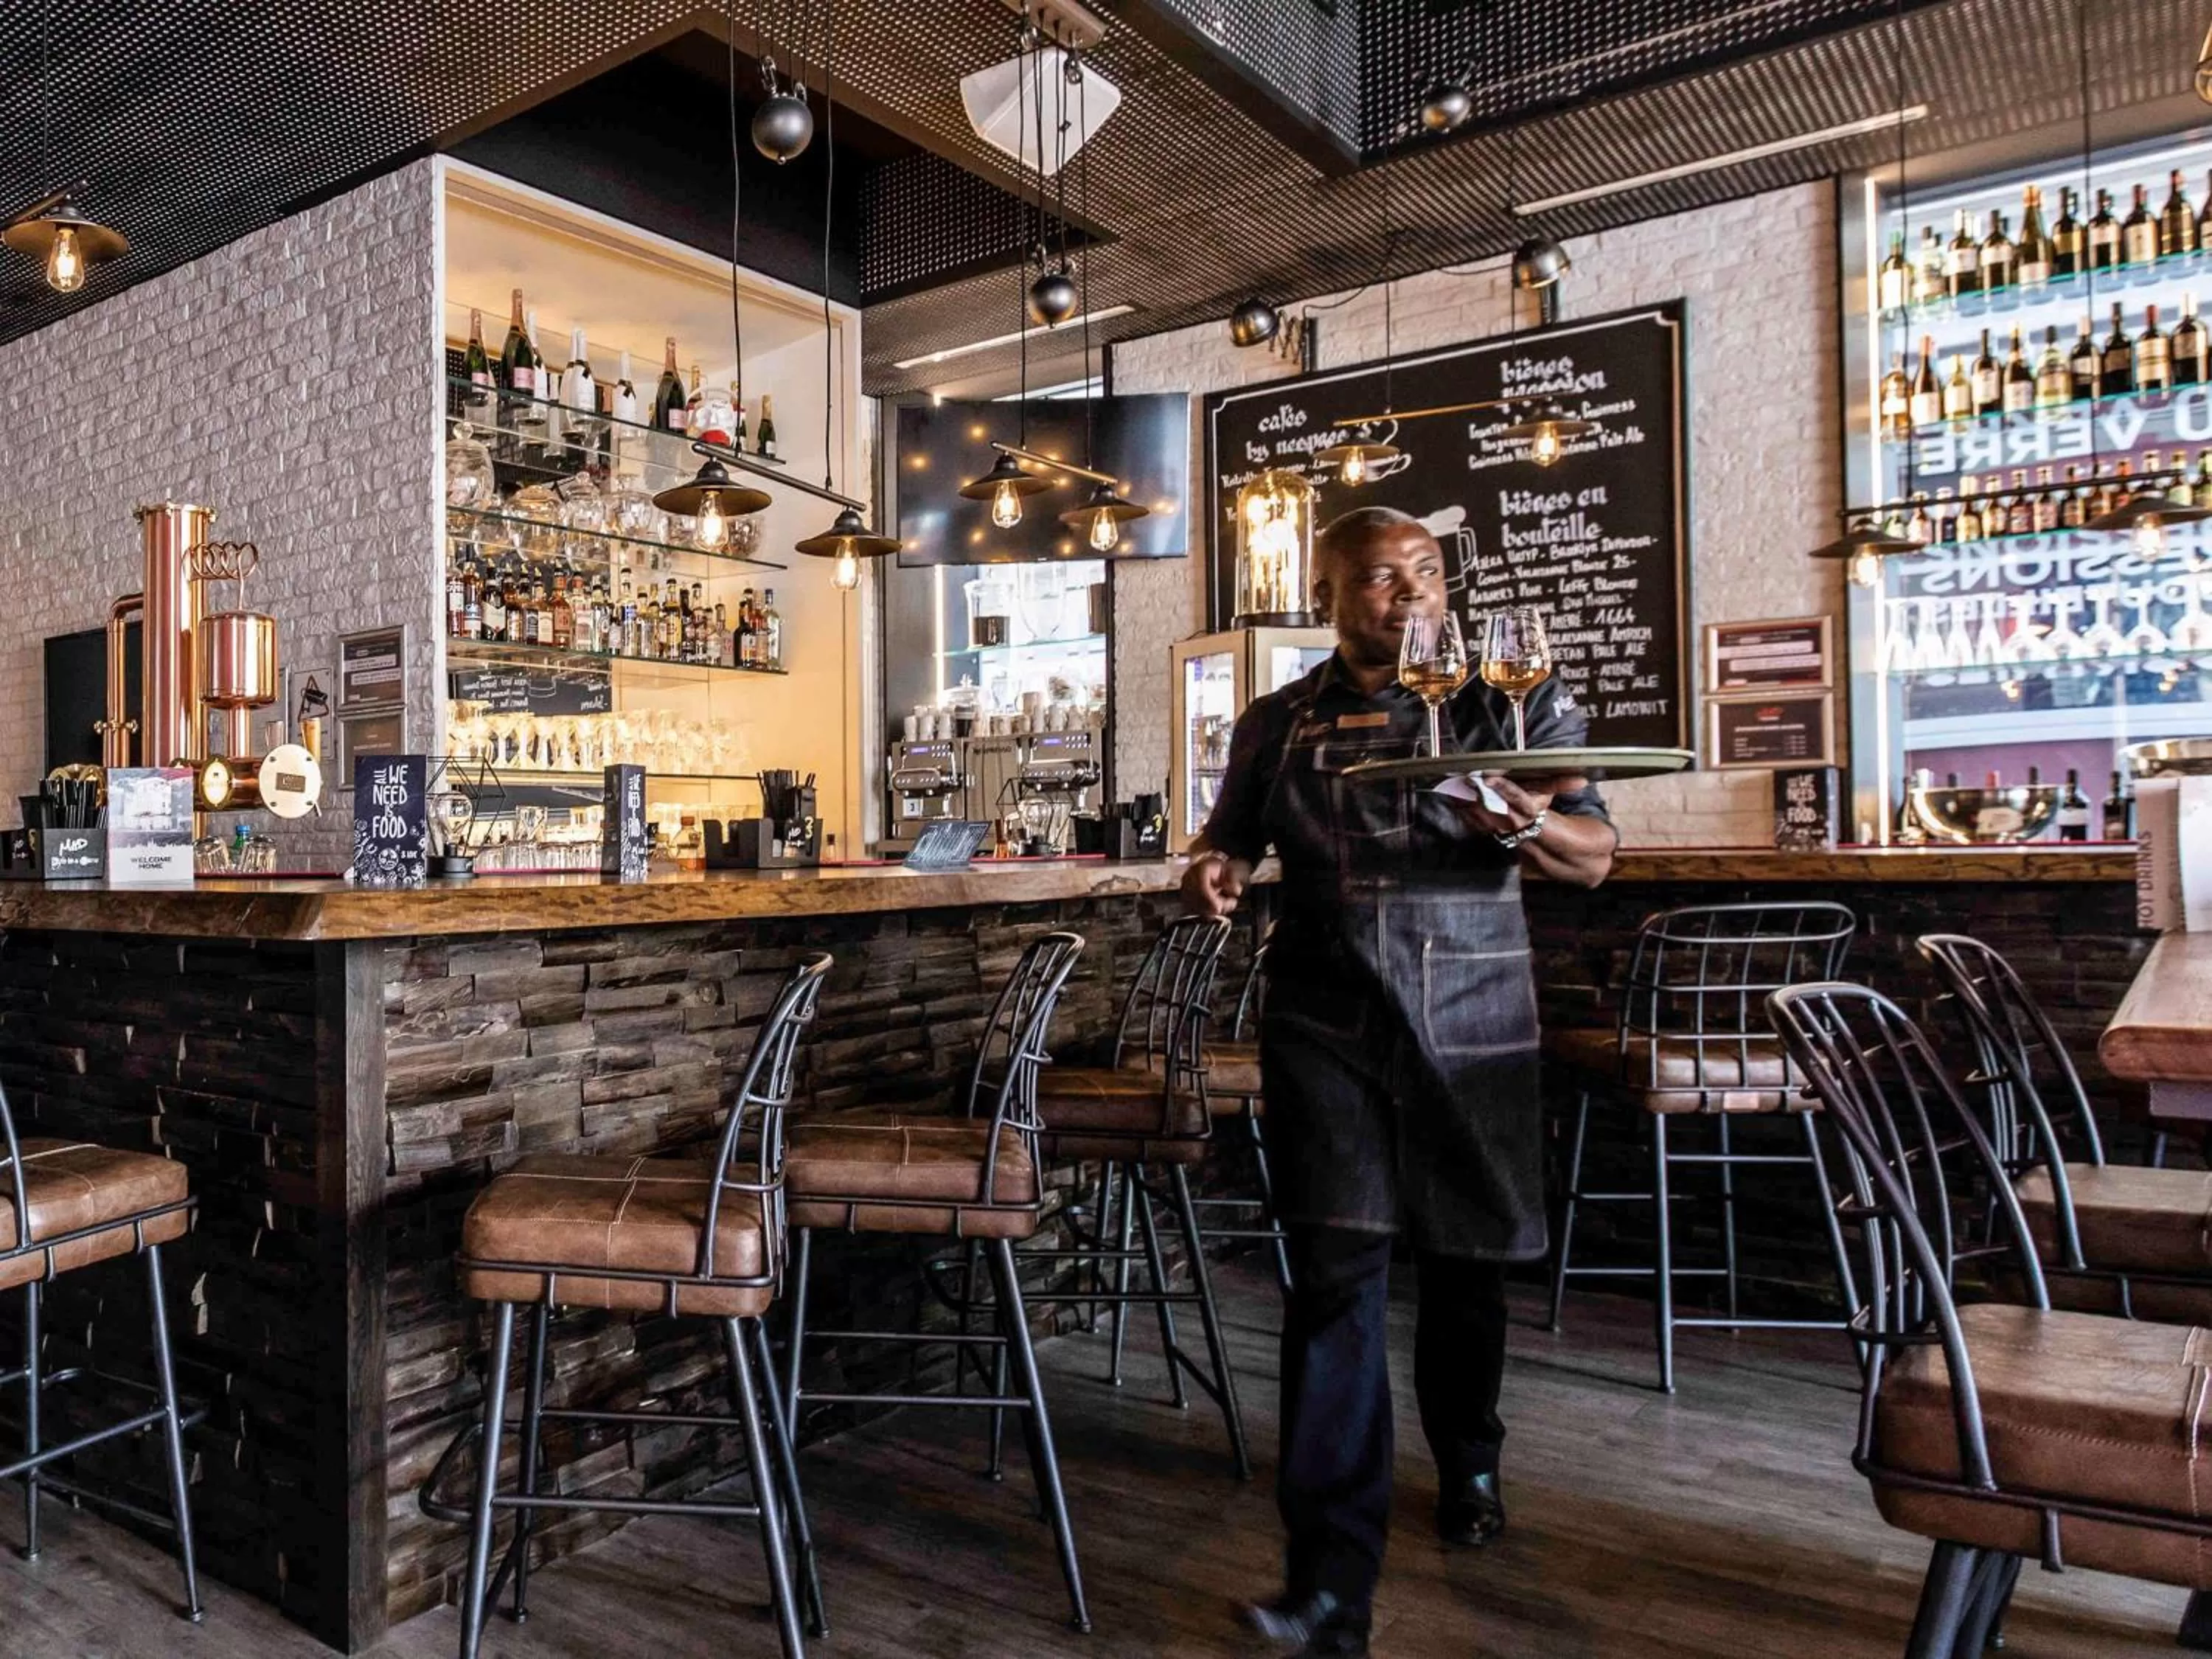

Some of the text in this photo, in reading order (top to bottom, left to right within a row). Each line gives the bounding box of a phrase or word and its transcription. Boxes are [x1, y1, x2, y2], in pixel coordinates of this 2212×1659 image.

[1576, 486, 1608, 507] en
[1500, 512, 1604, 549] bouteille
[1624, 641, 1647, 657] ALE
[373, 764, 409, 785] ALL WE
[372, 785, 408, 806] NEED
[372, 815, 408, 838] FOOD
[2138, 830, 2153, 891] DRINKS
